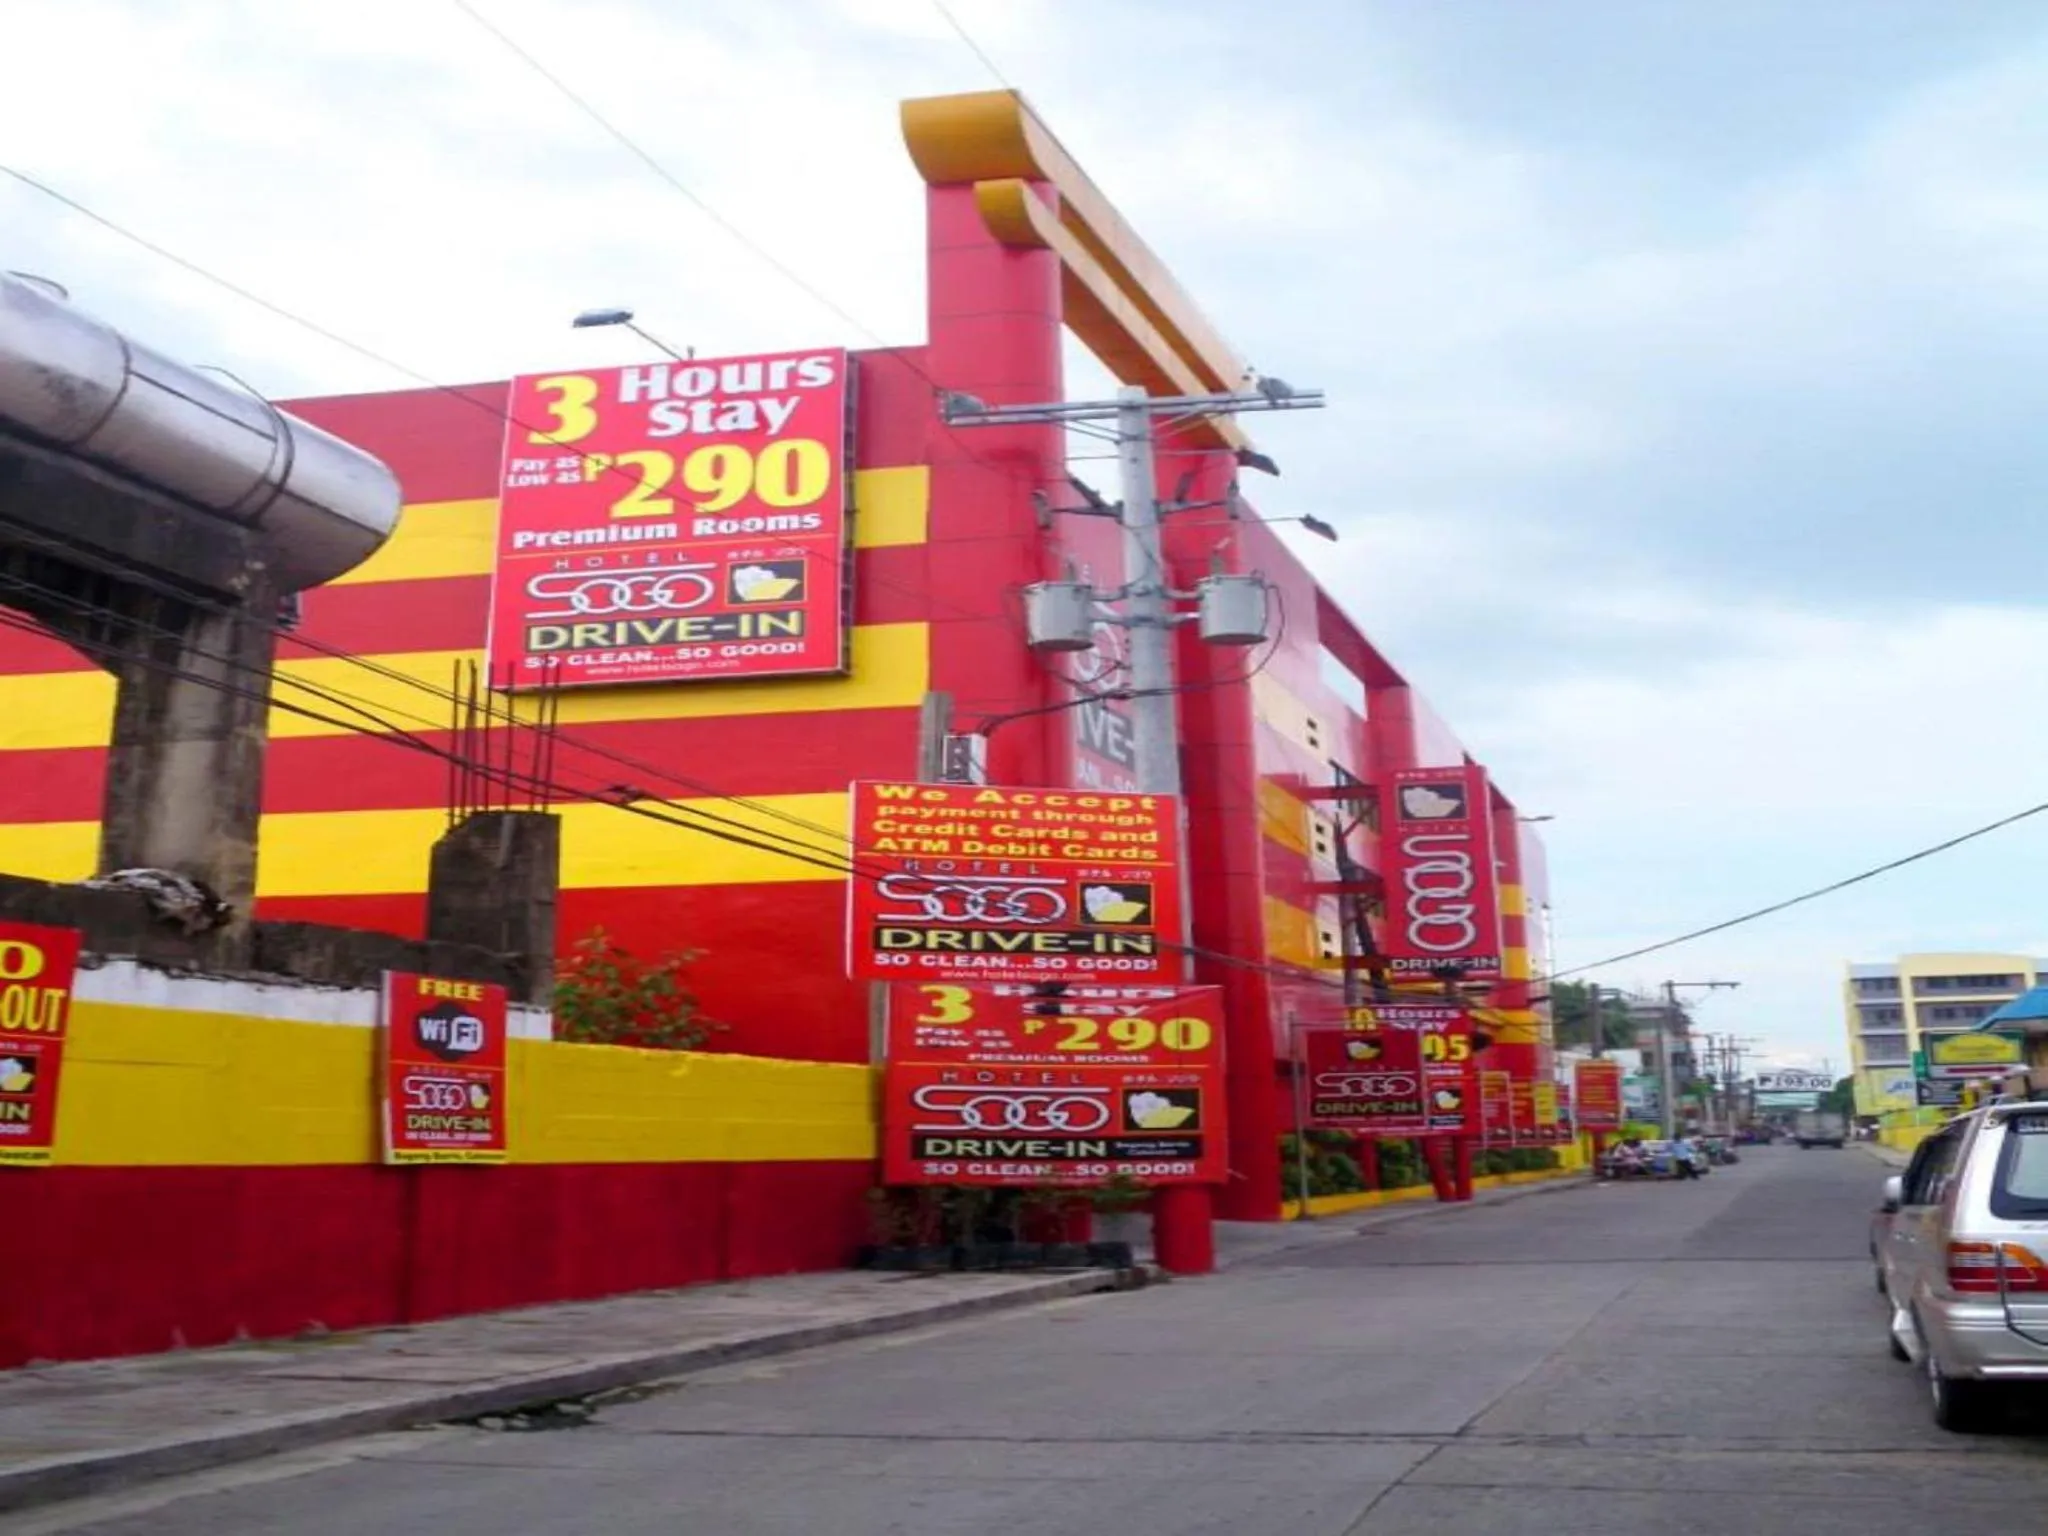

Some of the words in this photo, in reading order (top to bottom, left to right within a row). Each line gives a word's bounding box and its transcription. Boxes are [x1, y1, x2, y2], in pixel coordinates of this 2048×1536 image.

[618, 355, 834, 402] Hours
[528, 375, 598, 444] 3
[647, 396, 800, 437] Stay
[513, 522, 678, 549] Premium
[692, 514, 822, 536] Rooms
[554, 552, 689, 569] HOTEL
[525, 562, 717, 618] SOGO
[528, 610, 803, 651] DRIVE-IN
[524, 656, 559, 669] SO
[720, 642, 805, 657] GOOD!
[874, 784, 949, 801] We
[974, 789, 1158, 811] Accept
[877, 805, 1021, 819] payment
[1032, 810, 1155, 826] through
[872, 819, 980, 836] Credit
[991, 824, 1090, 841] Cards
[1100, 830, 1159, 843] and
[874, 837, 950, 853] ATM
[961, 840, 1052, 857] Debit
[1062, 844, 1158, 860] Cards
[904, 859, 1041, 876] HOTEL
[877, 873, 1068, 924] SOGO
[880, 928, 1153, 954] DRIVE-IN
[874, 953, 913, 967] SO
[1076, 957, 1158, 971] GOOD!
[418, 978, 486, 1001] FREE
[917, 984, 975, 1025] 3
[1377, 1007, 1462, 1019] Hours
[942, 1071, 1082, 1083] HOTEL
[404, 1075, 467, 1110] SOGO
[912, 1085, 1112, 1131] SOGO
[925, 1139, 1106, 1157] DRIVE-IN
[923, 1163, 960, 1174] SO
[1117, 1163, 1195, 1174] GOOD!
